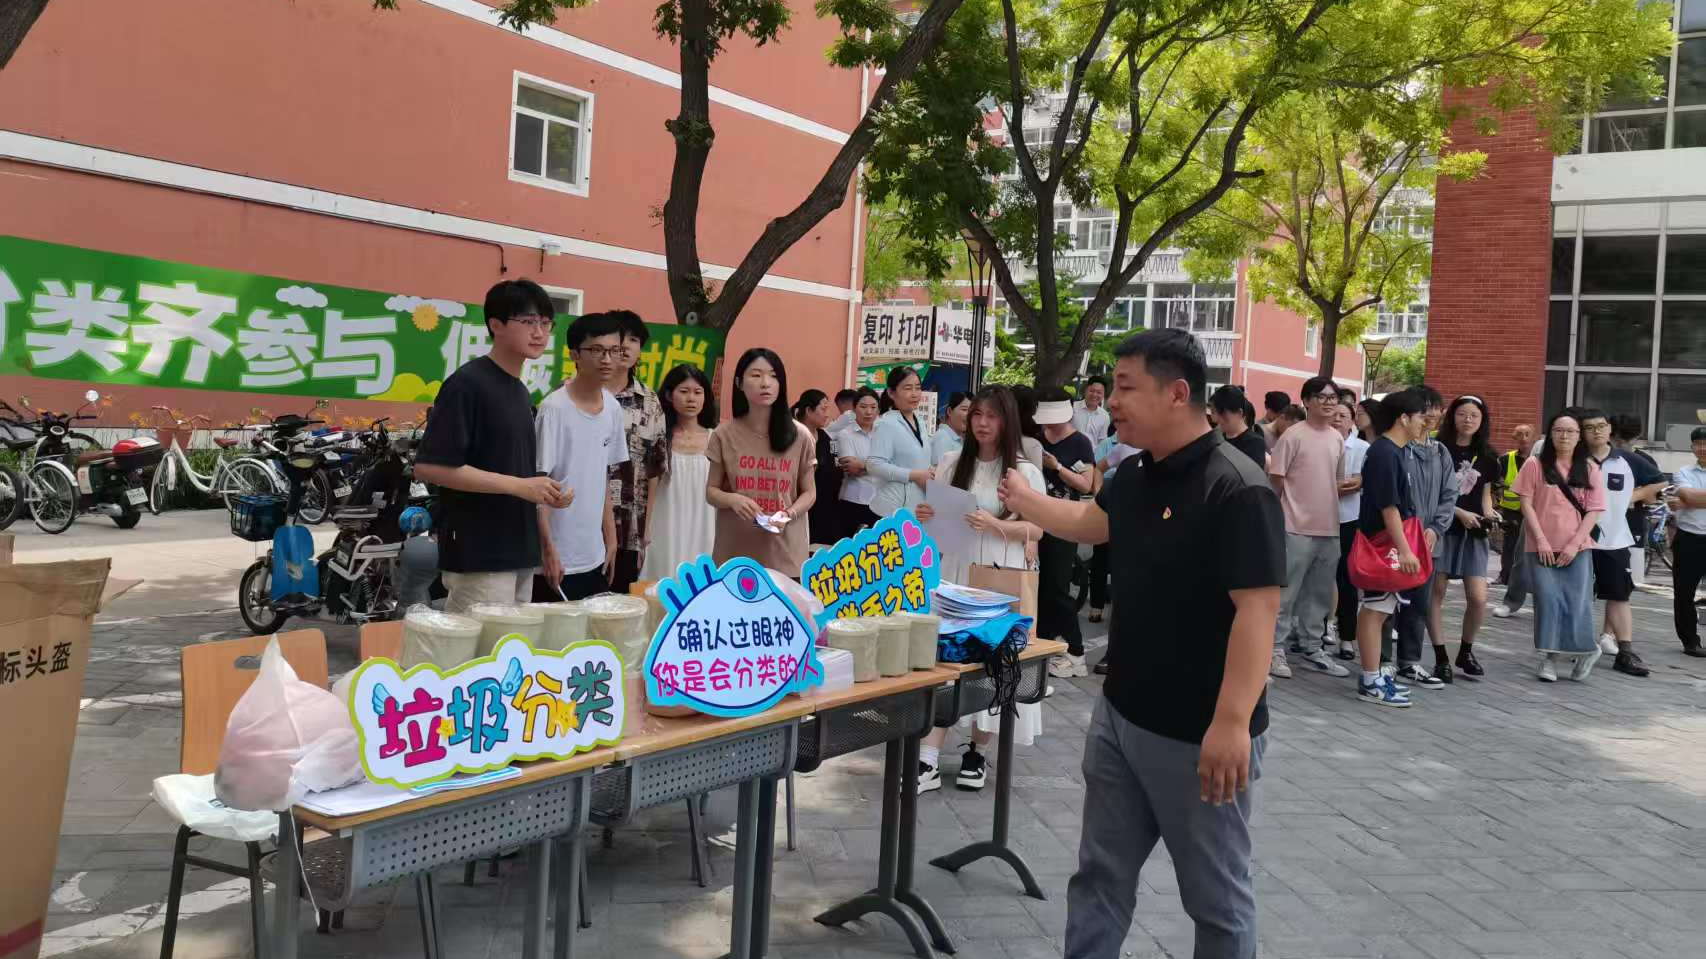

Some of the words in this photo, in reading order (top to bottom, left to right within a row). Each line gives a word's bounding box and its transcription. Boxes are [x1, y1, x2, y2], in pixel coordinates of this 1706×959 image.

[0, 266, 397, 395] 类齐参与
[863, 312, 894, 345] 复印
[897, 312, 930, 346] 打印
[739, 455, 756, 469] GO
[757, 456, 776, 471] ALL
[780, 458, 791, 473] IN
[757, 477, 777, 491] BET
[808, 528, 904, 608] 垃圾分类
[676, 615, 795, 653] 确认过眼神
[653, 651, 820, 698] 你是会分类的人
[377, 660, 614, 768] 垃圾分类
